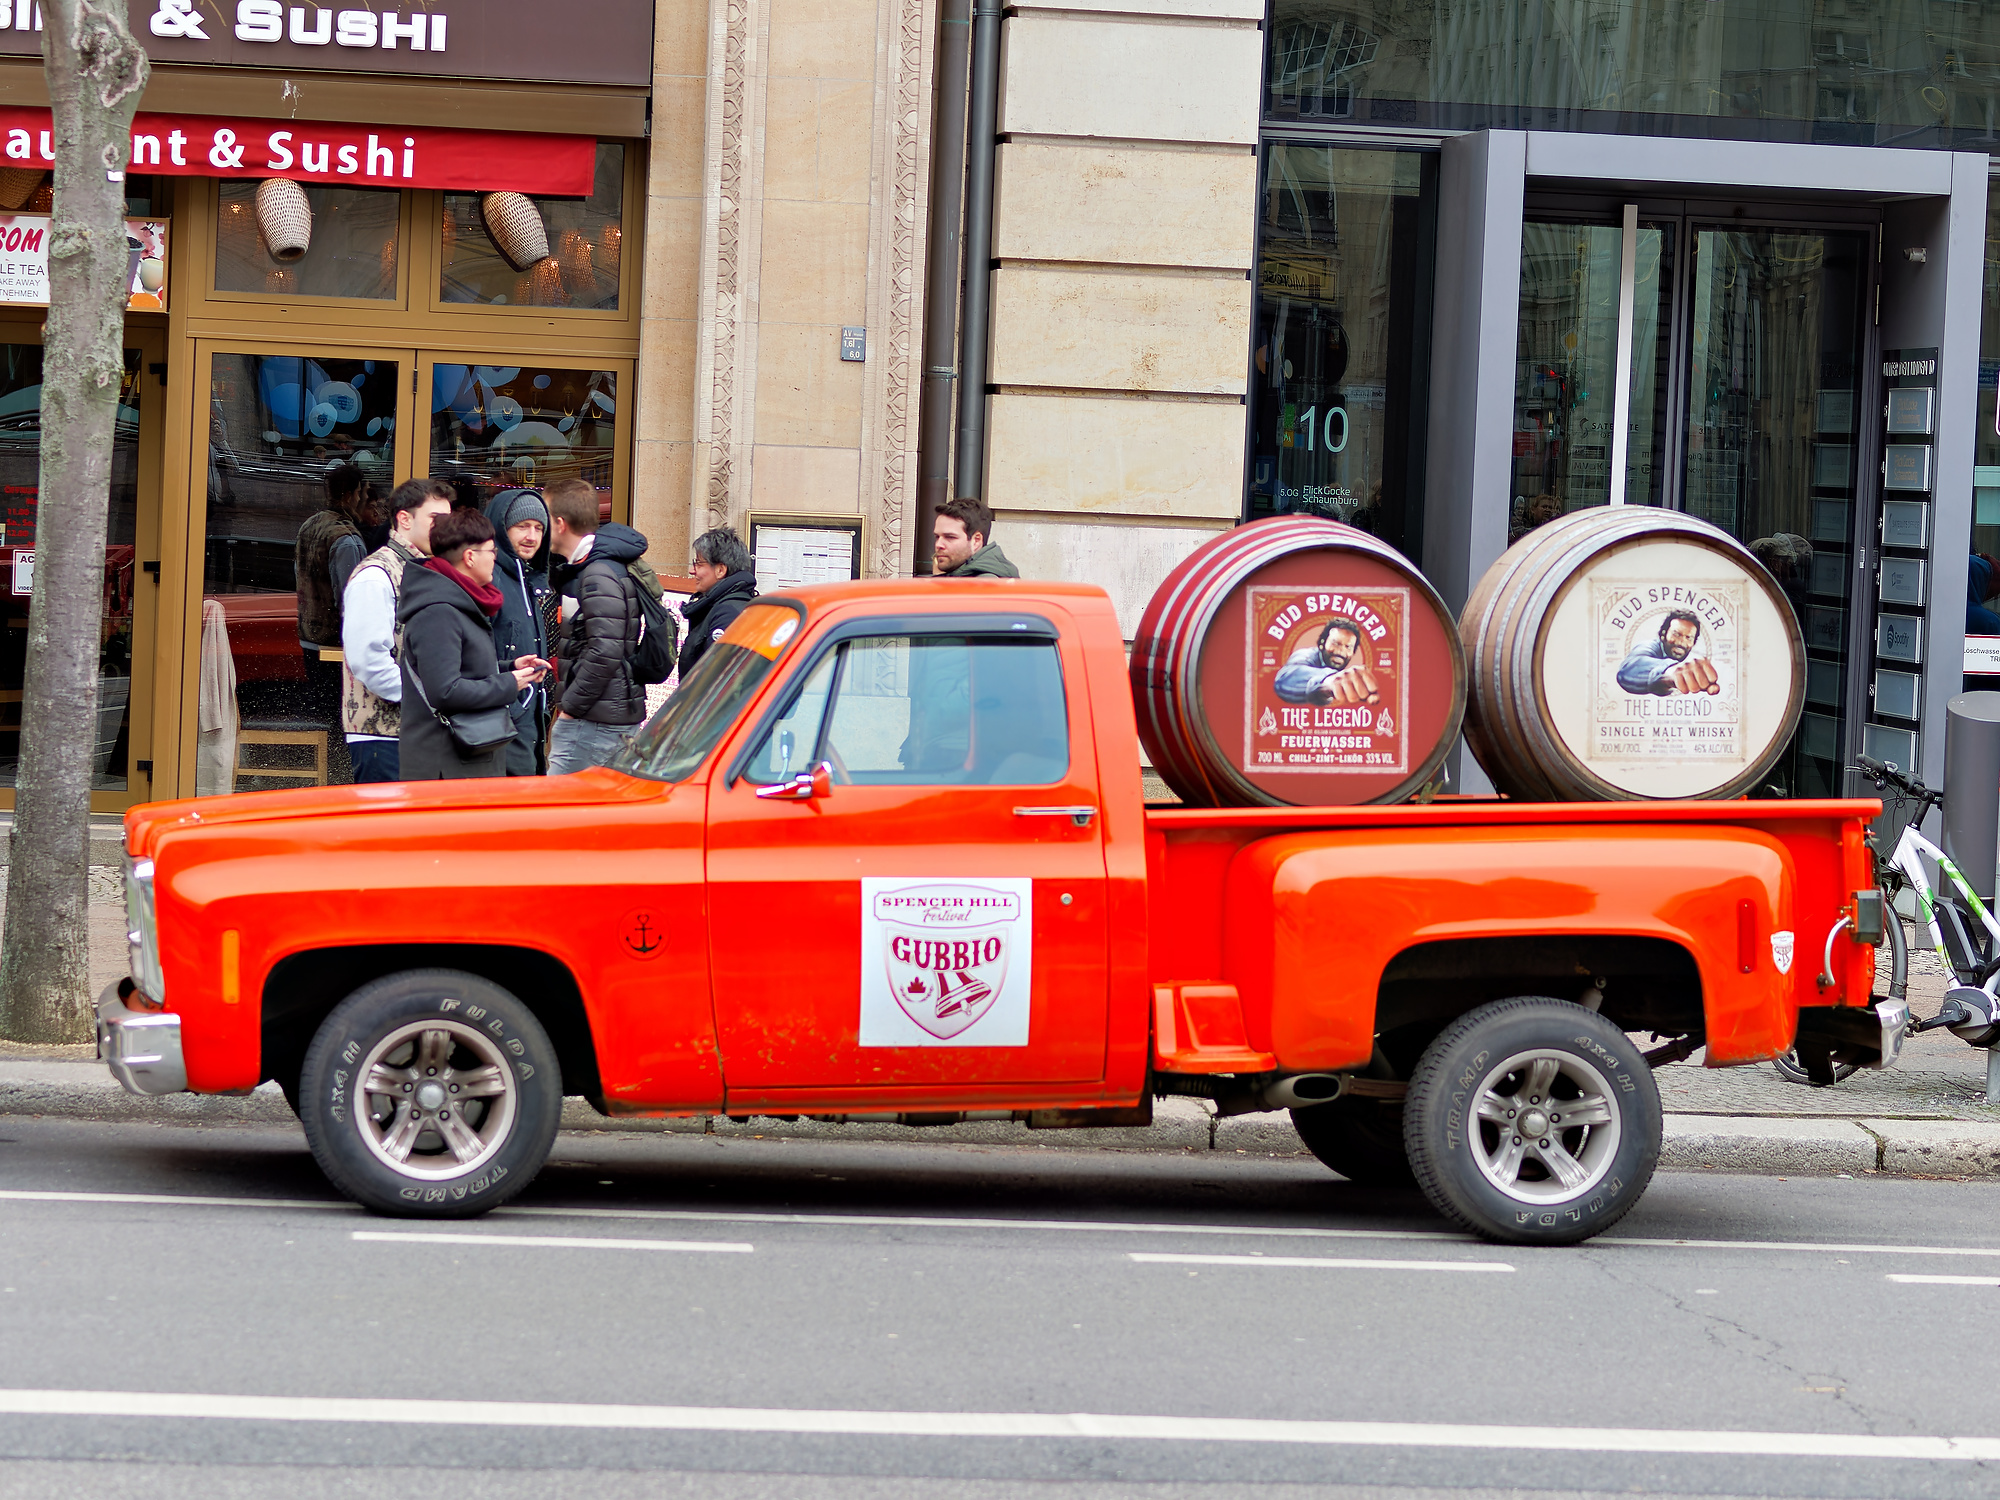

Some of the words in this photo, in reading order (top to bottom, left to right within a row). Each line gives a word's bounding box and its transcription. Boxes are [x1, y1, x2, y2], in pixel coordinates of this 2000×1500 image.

[150, 0, 211, 40] &
[235, 0, 447, 51] SUSHI
[6, 128, 188, 166] aunt
[208, 128, 245, 168] &
[267, 131, 415, 178] Sushi
[16, 279, 41, 287] AWAY
[20, 264, 45, 276] TEA
[1300, 405, 1349, 453] 10
[1302, 494, 1358, 507] Schaumburg
[1267, 604, 1302, 640] BUD
[1305, 594, 1387, 641] SPENCER
[1611, 597, 1643, 630] BUD
[1648, 586, 1726, 631] SPENCER
[1894, 631, 1910, 648] Spotify
[1281, 707, 1310, 729] THE
[1314, 706, 1372, 728] LEGEND
[1624, 699, 1651, 718] THE
[1657, 696, 1712, 717] LEGEND
[1281, 735, 1372, 749] FEUERWASSER
[1600, 726, 1645, 738] SINGLE
[1652, 726, 1683, 738] MALT
[1688, 727, 1734, 738] WHISKY
[882, 897, 964, 907] SPENCER
[969, 898, 1012, 907] HILL
[923, 907, 972, 923] Festival
[892, 936, 1002, 971] GUBBIO
[440, 998, 535, 1081] FULDA
[1447, 1050, 1490, 1150] TRAMP
[400, 1165, 508, 1203] TRAMP
[1516, 1177, 1623, 1226] FULDA
